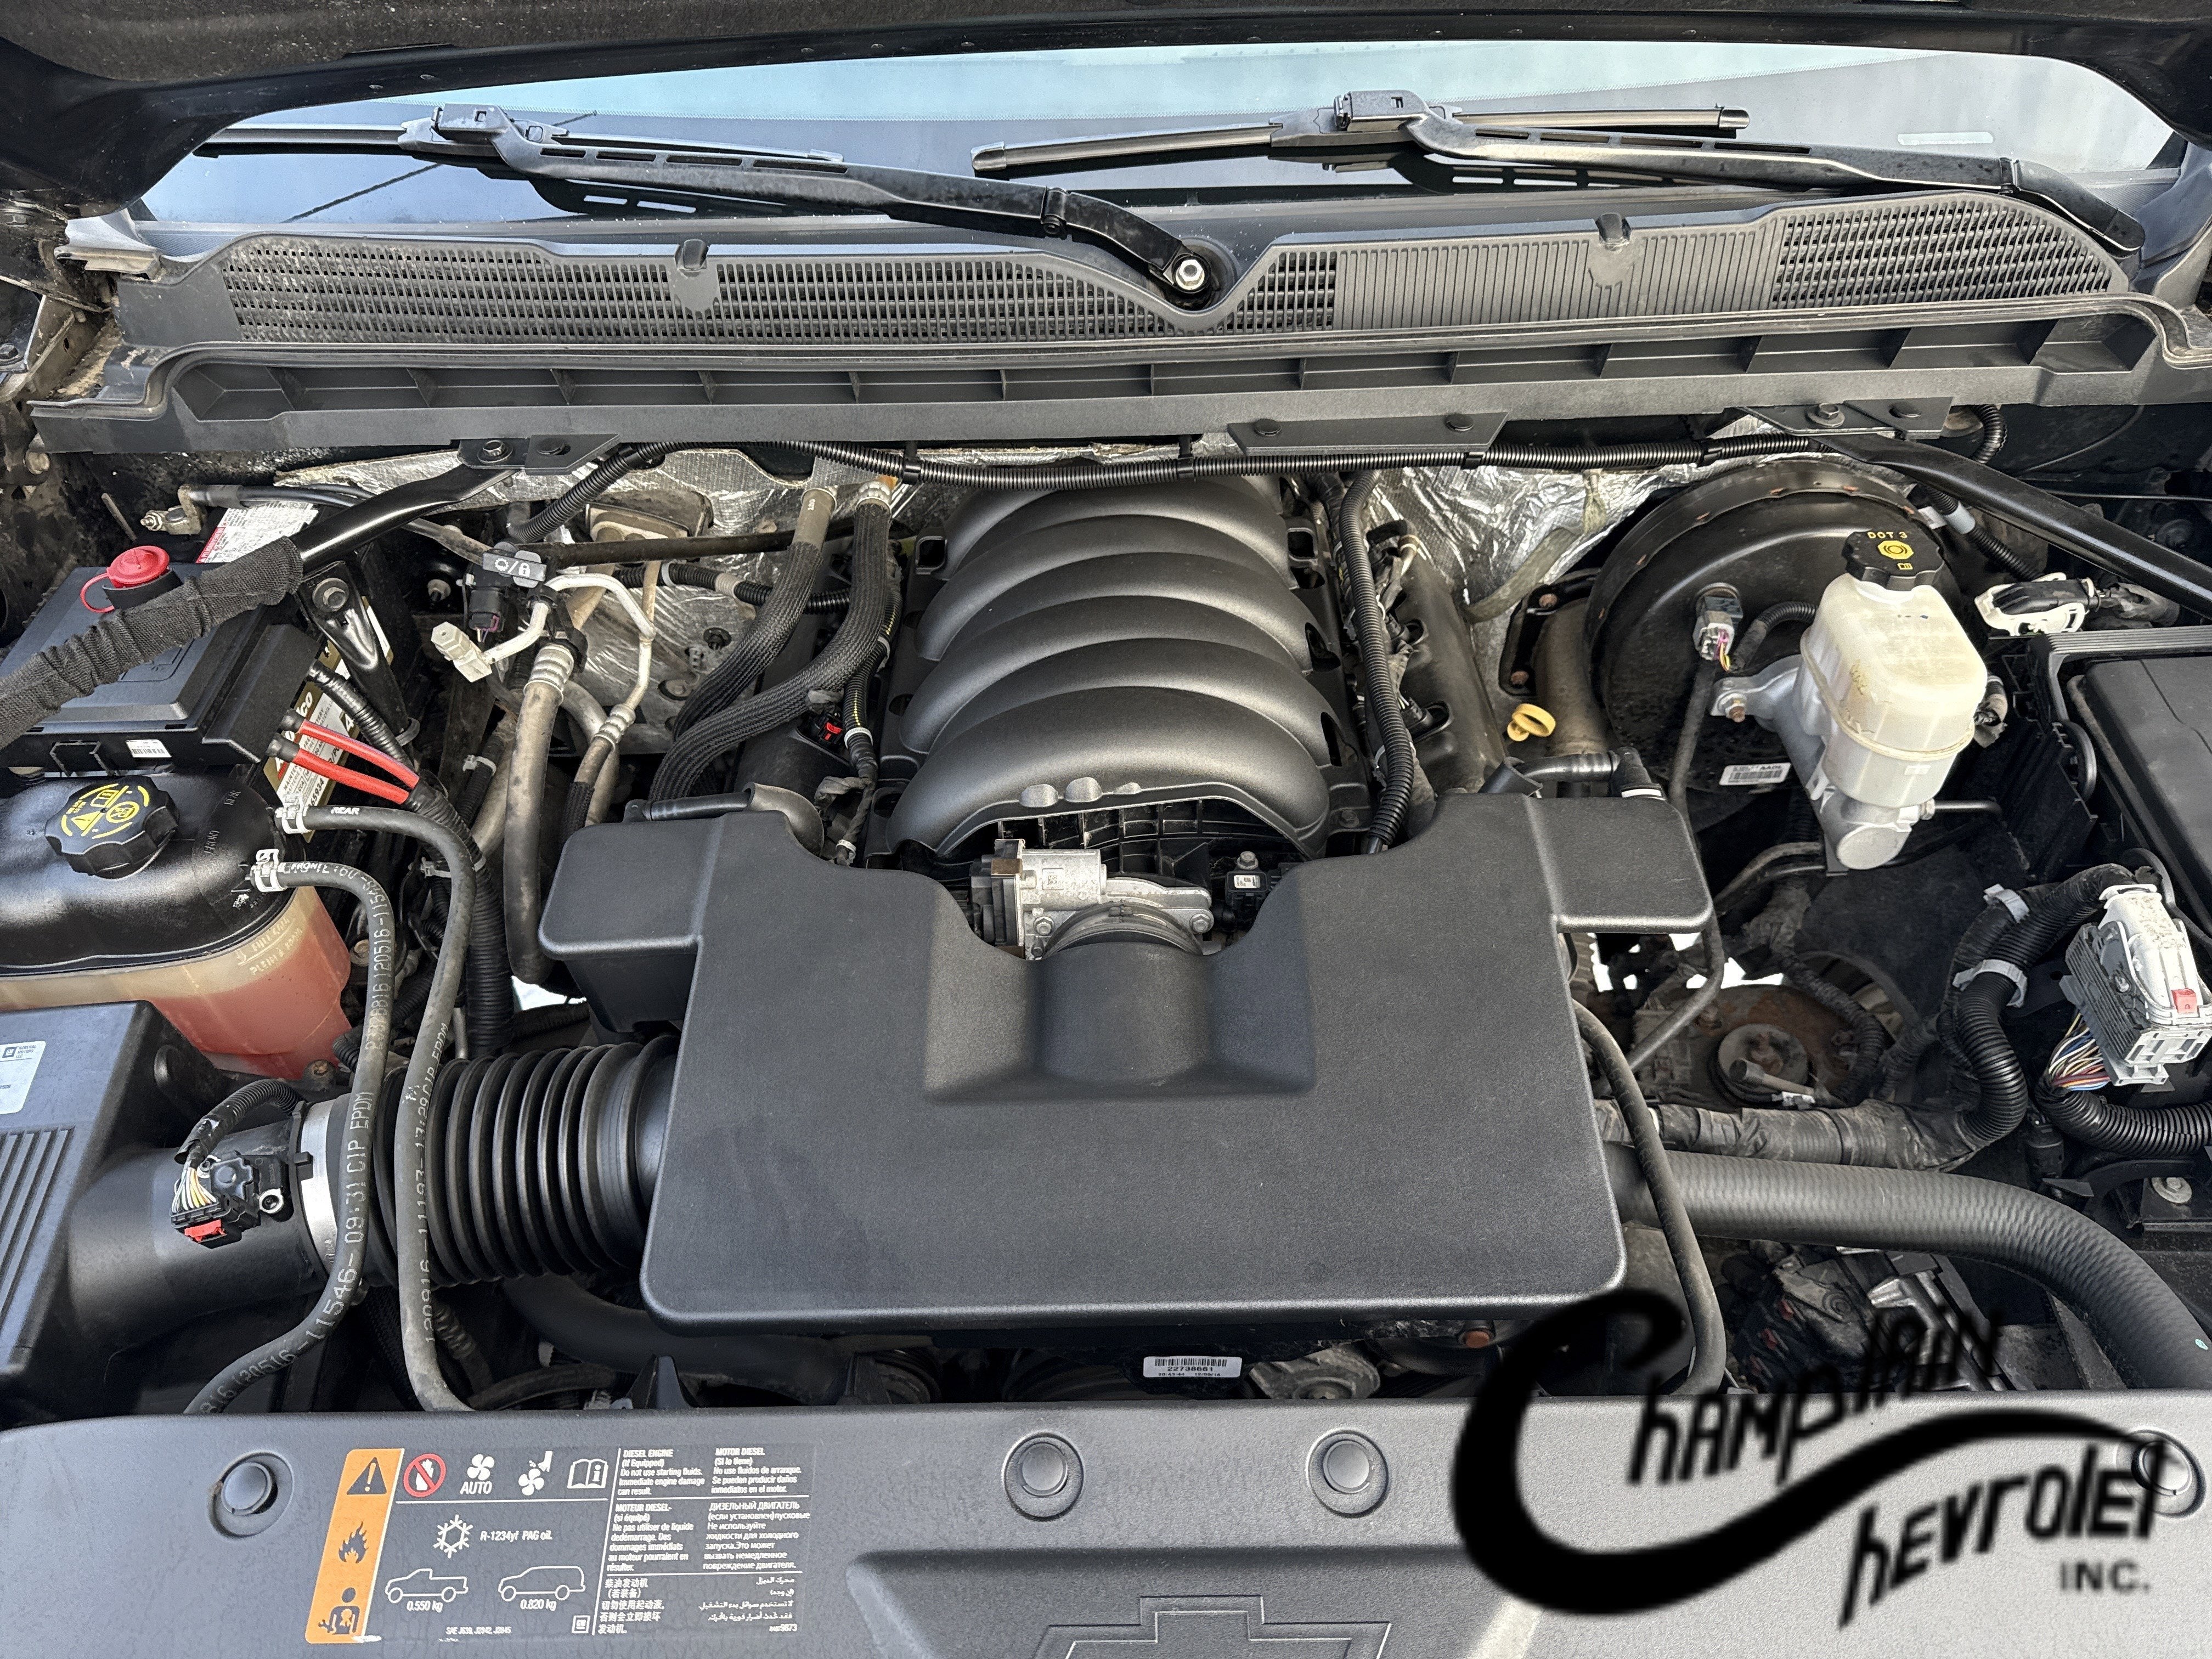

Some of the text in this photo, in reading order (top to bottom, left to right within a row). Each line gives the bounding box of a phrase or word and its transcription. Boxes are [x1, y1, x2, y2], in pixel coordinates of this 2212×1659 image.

[331, 806, 360, 815] REAR
[349, 1091, 374, 1130] EPDM
[623, 1449, 674, 1458] DIESEL ENGINE
[741, 1447, 765, 1455] DIESEL
[631, 1459, 665, 1468] Equipped)
[733, 1457, 753, 1466] tiene)
[656, 1468, 682, 1477] starting
[770, 1466, 802, 1475] arranque.
[654, 1477, 677, 1487] engine
[678, 1477, 706, 1486] damage
[723, 1476, 747, 1485] pueden
[748, 1476, 776, 1485] producir
[460, 1481, 493, 1494] AUTO
[615, 1504, 645, 1512] MOTEUR
[709, 1501, 800, 1511] ДИЗЕЛЬНЫЙ ДВИГАТЕЛЬ
[624, 1513, 650, 1523] équipé)
[708, 1513, 728, 1521] (если
[623, 1525, 636, 1533] pas
[637, 1523, 660, 1531] utiliser
[671, 1522, 694, 1532] liquide
[719, 1522, 766, 1531] используйте
[480, 1531, 520, 1543] R-1234yf
[522, 1530, 540, 1541] PAG
[658, 1532, 672, 1541] Des
[759, 1532, 799, 1540] холодного
[610, 1542, 684, 1553] dommages immédiats
[618, 1553, 643, 1561] moteur
[643, 1552, 679, 1562] pourraient
[736, 1552, 788, 1560] немедленное
[703, 1562, 797, 1571] повреждение двигателя.
[605, 1578, 648, 1588] 柴油发动机
[407, 1600, 443, 1613] 0.550 kg
[520, 1599, 557, 1612] 0.820 kg
[600, 1611, 661, 1622] 否则会立即损坏
